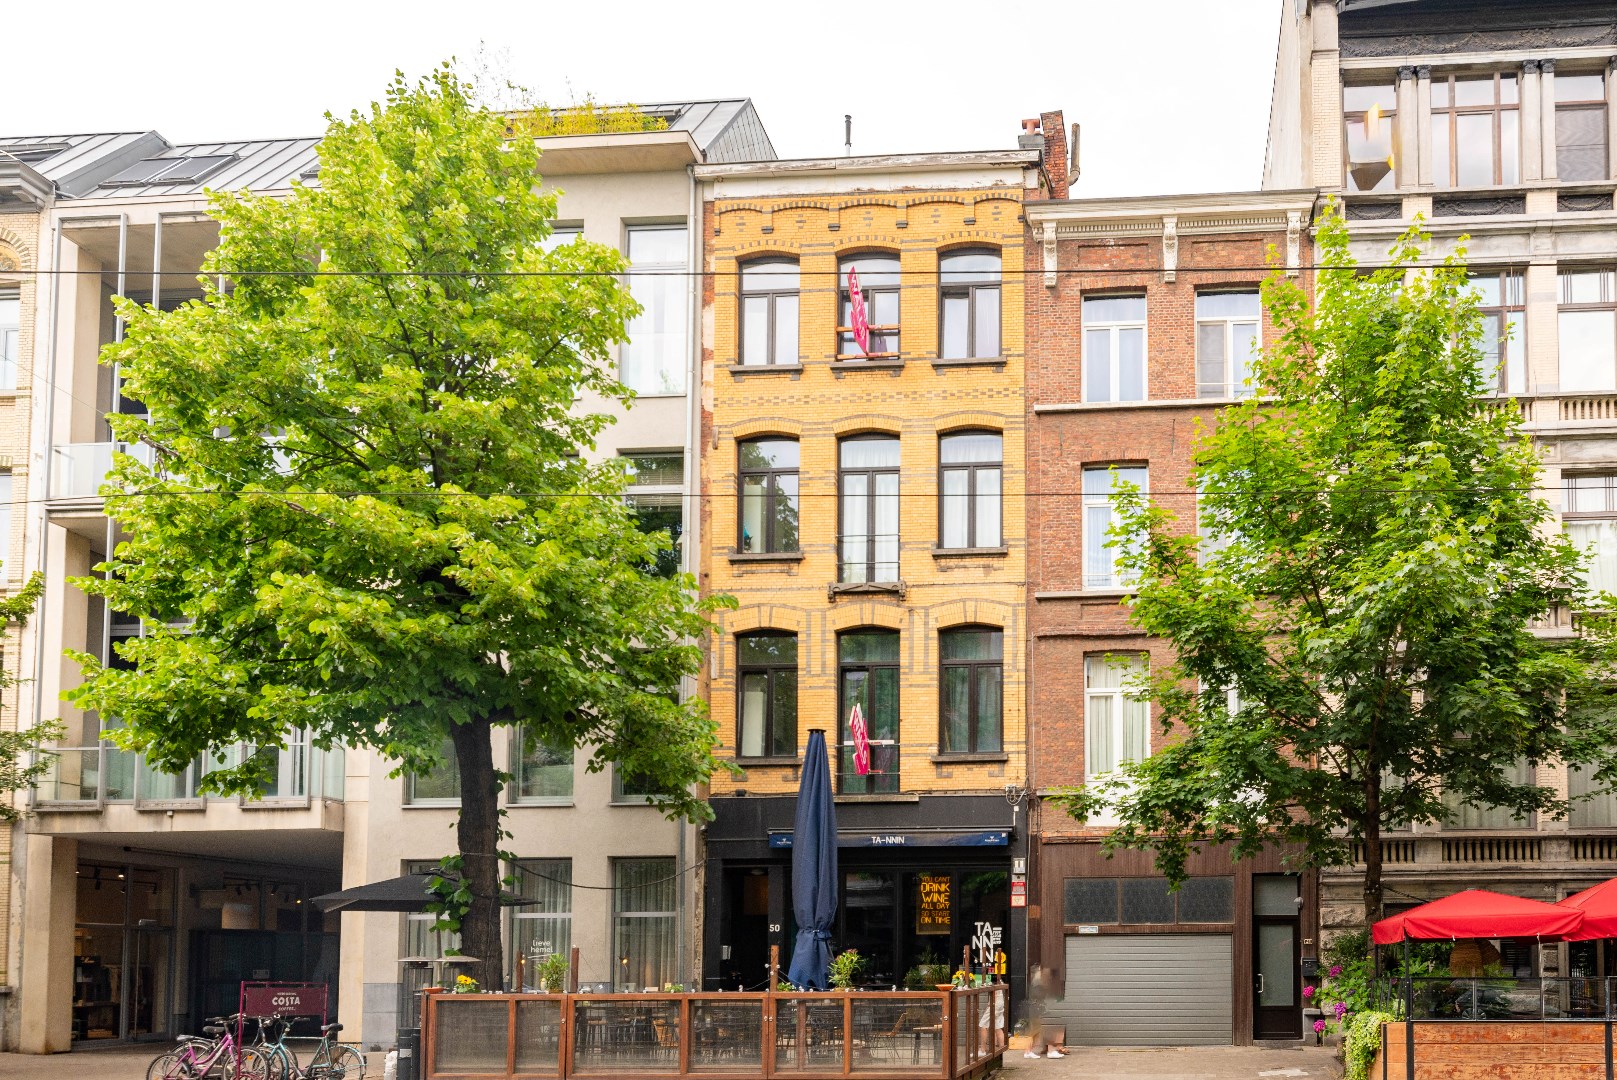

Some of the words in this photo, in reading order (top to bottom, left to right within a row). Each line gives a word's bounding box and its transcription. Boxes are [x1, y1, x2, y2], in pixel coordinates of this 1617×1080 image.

[871, 836, 904, 844] TA-NNIN
[921, 883, 950, 892] DRINK
[922, 892, 950, 903] WINE
[769, 924, 780, 932] 50
[974, 921, 993, 936] TA
[533, 937, 551, 946] lieve
[530, 945, 553, 953] hemel
[272, 996, 300, 1006] COSTA
